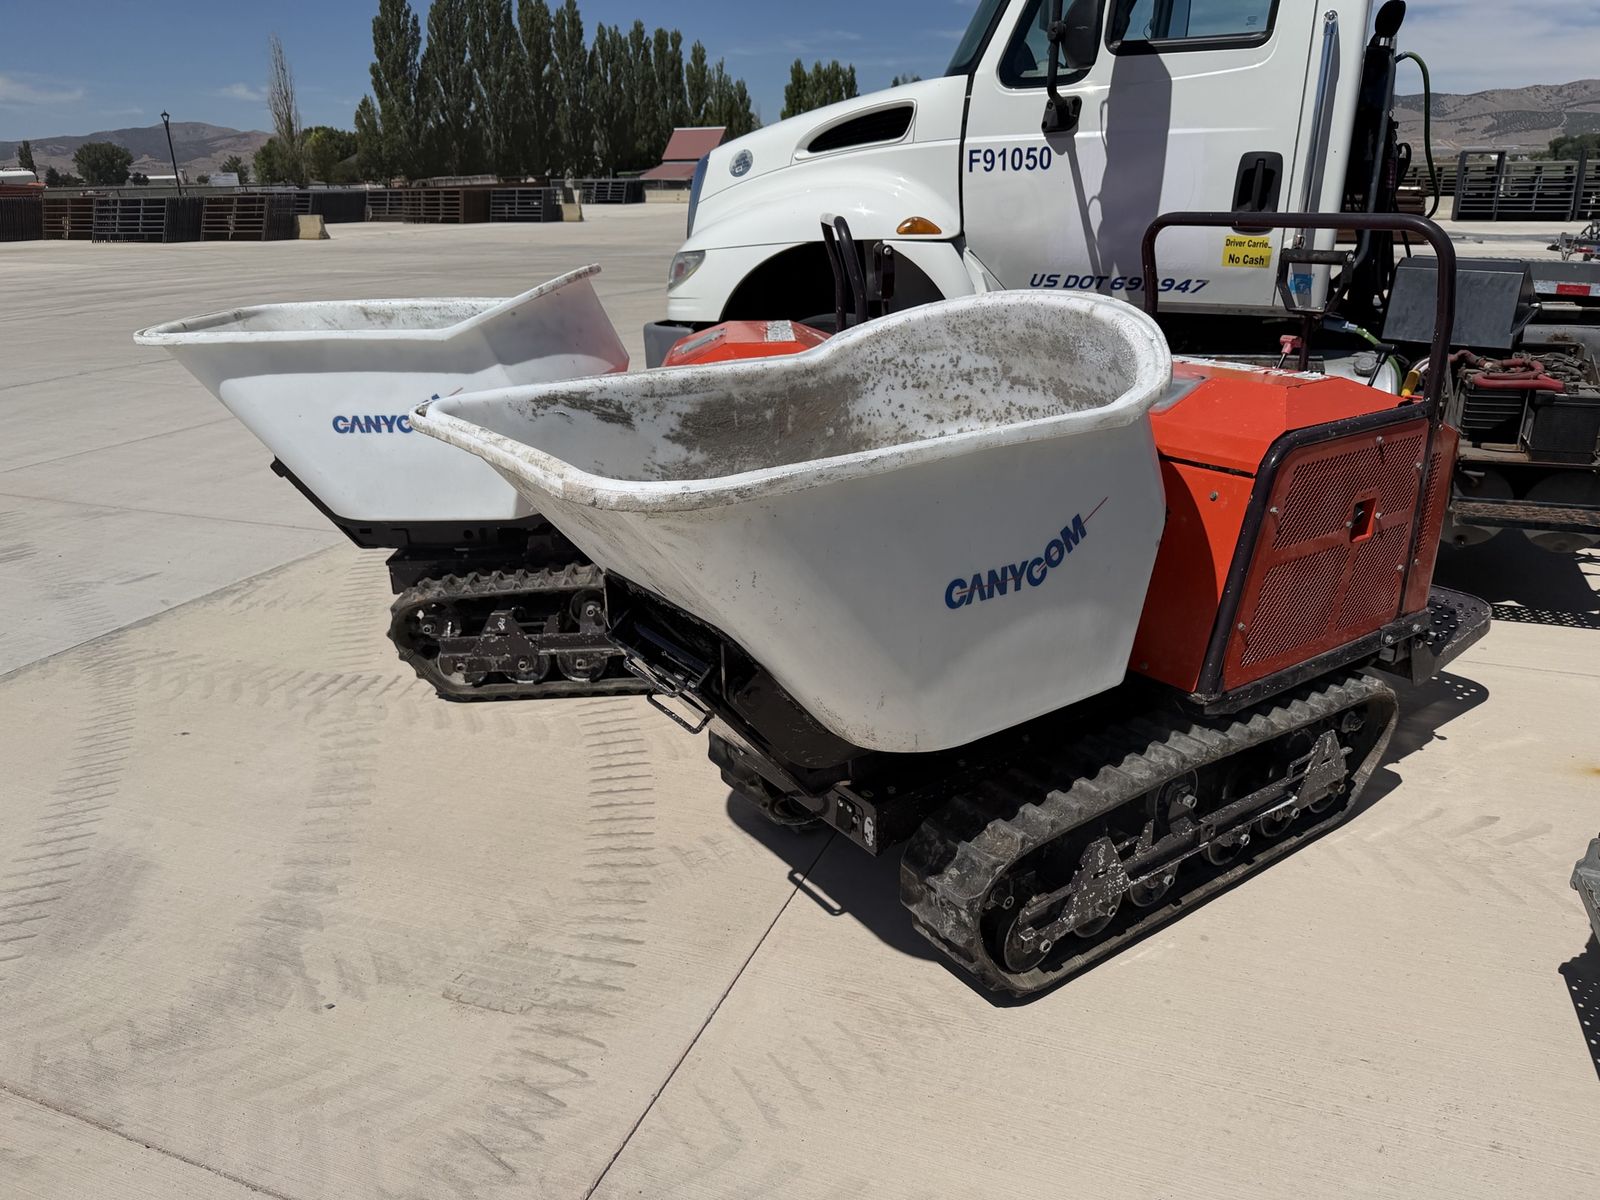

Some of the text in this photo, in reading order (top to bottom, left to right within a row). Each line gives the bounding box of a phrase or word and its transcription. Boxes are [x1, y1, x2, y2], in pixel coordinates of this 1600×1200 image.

[968, 146, 1052, 173] F91050
[1225, 238, 1272, 249] Driver Carrie
[1228, 253, 1265, 265] No Cash
[1029, 273, 1210, 293] US DOT 69947
[944, 513, 1087, 610] CANYCOM
